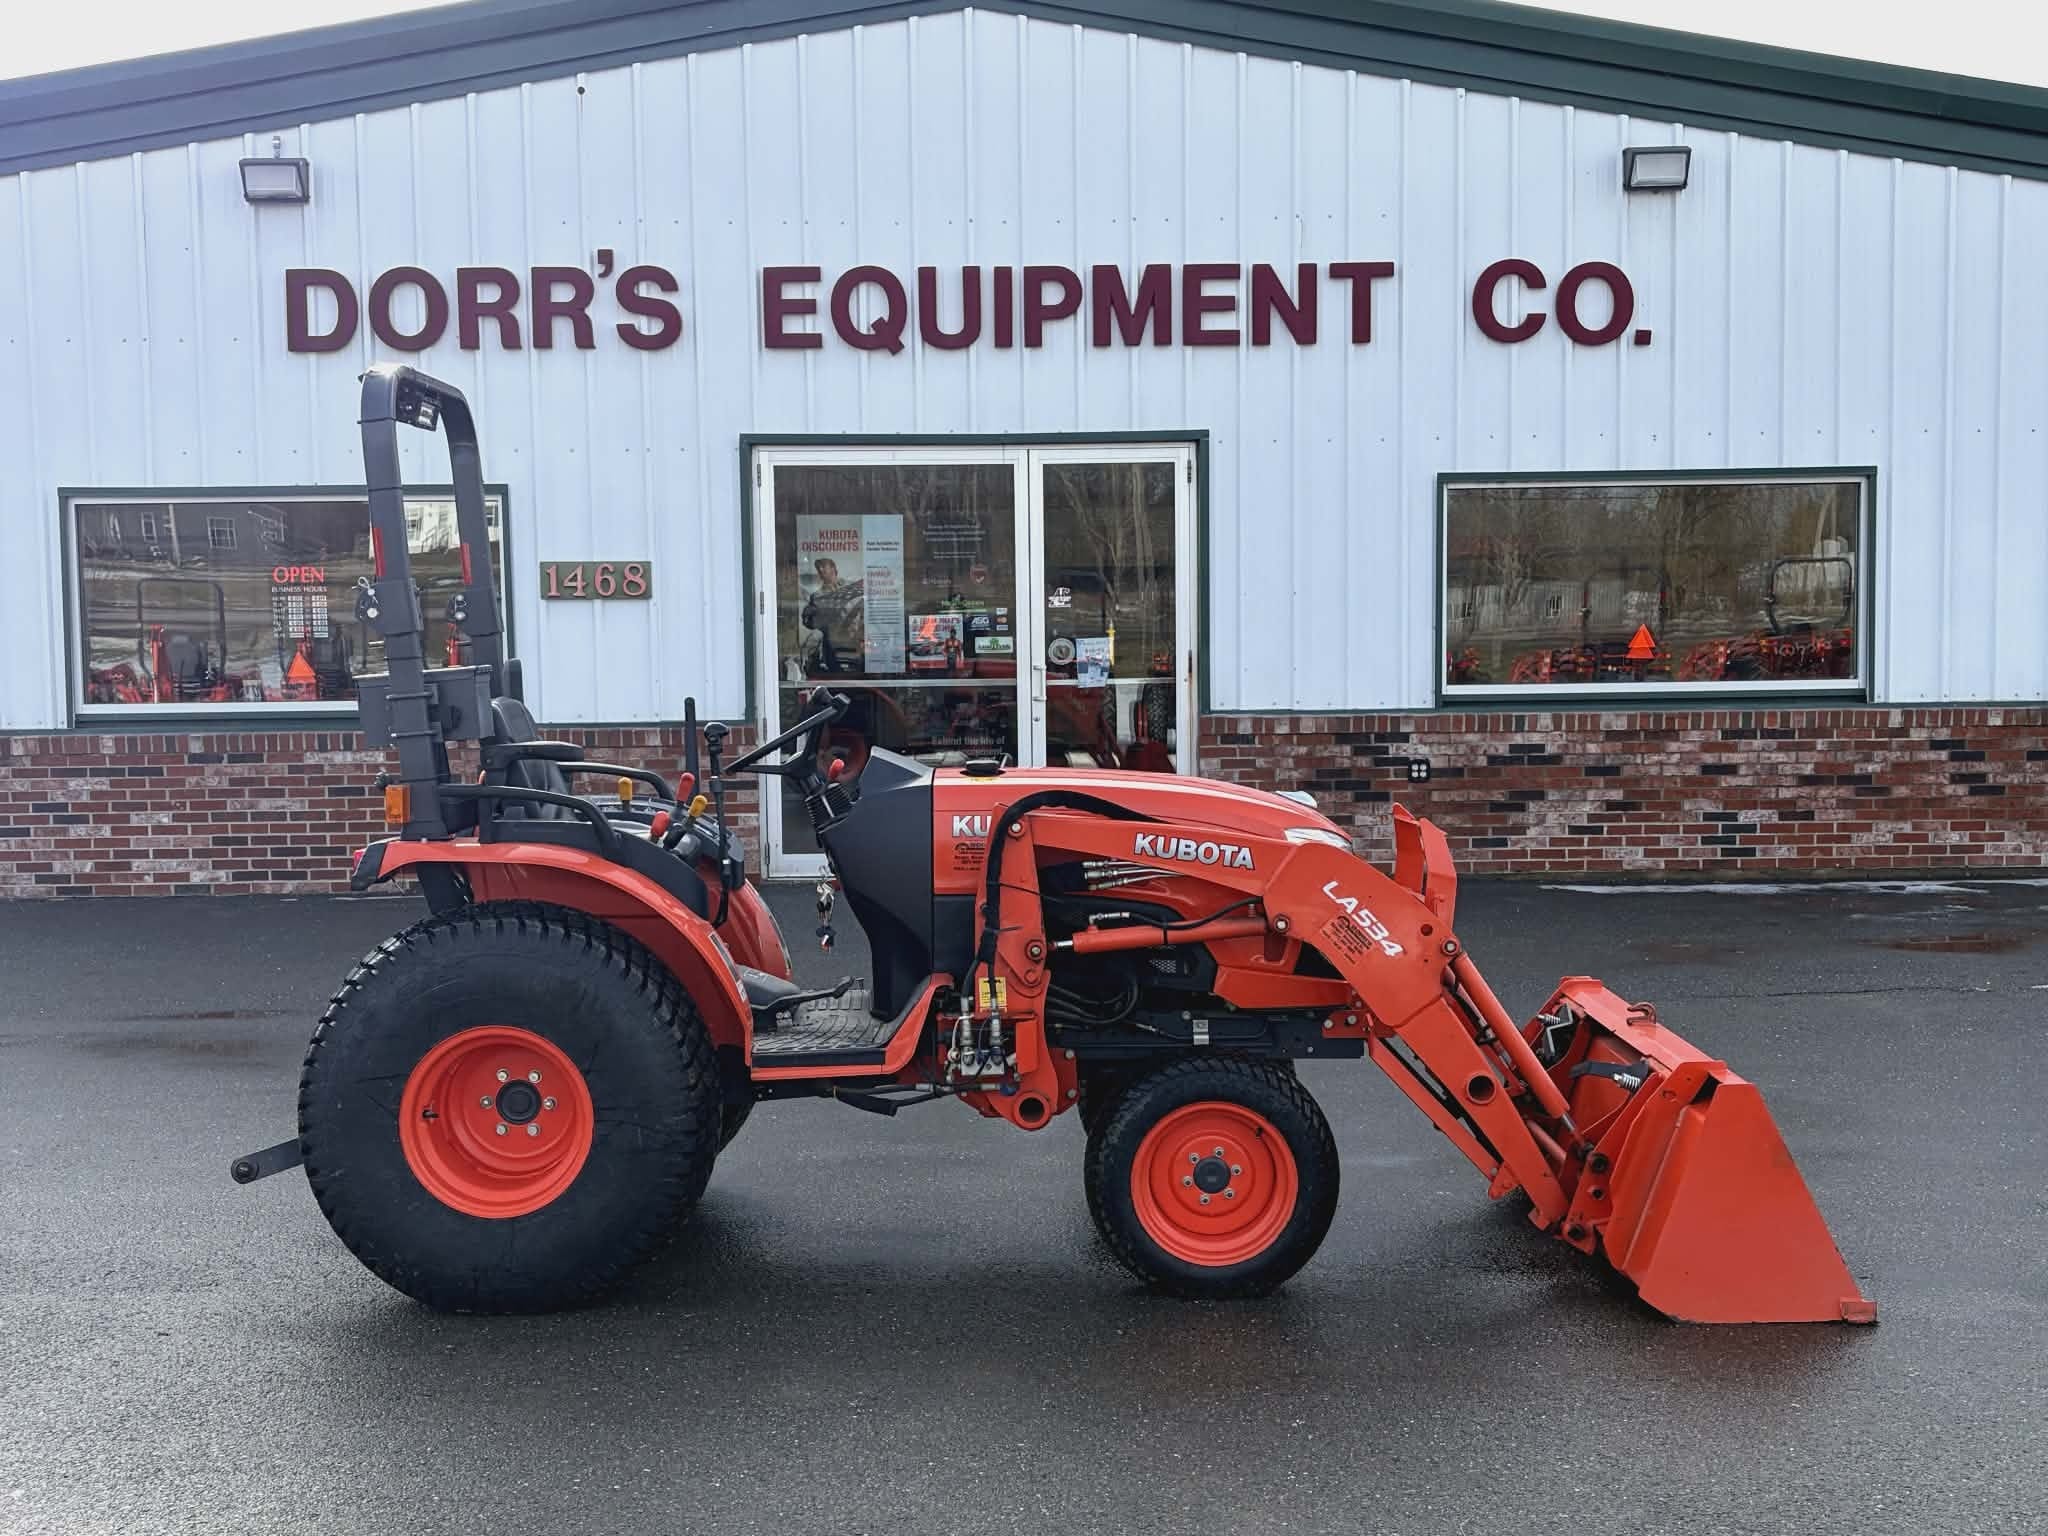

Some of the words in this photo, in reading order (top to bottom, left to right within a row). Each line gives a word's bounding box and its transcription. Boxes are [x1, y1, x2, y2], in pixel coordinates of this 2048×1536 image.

[285, 249, 683, 352] DORR'S
[763, 262, 1395, 356] EQUIPMENT
[1472, 258, 1652, 347] CO.
[800, 541, 859, 552] DISCOUNTS
[819, 529, 859, 539] KUBOTA
[271, 565, 325, 584] OPEN
[545, 562, 649, 598] 1468
[952, 815, 993, 838] KU
[1134, 832, 1256, 870] KUBOTA
[1322, 880, 1404, 957] LA534
